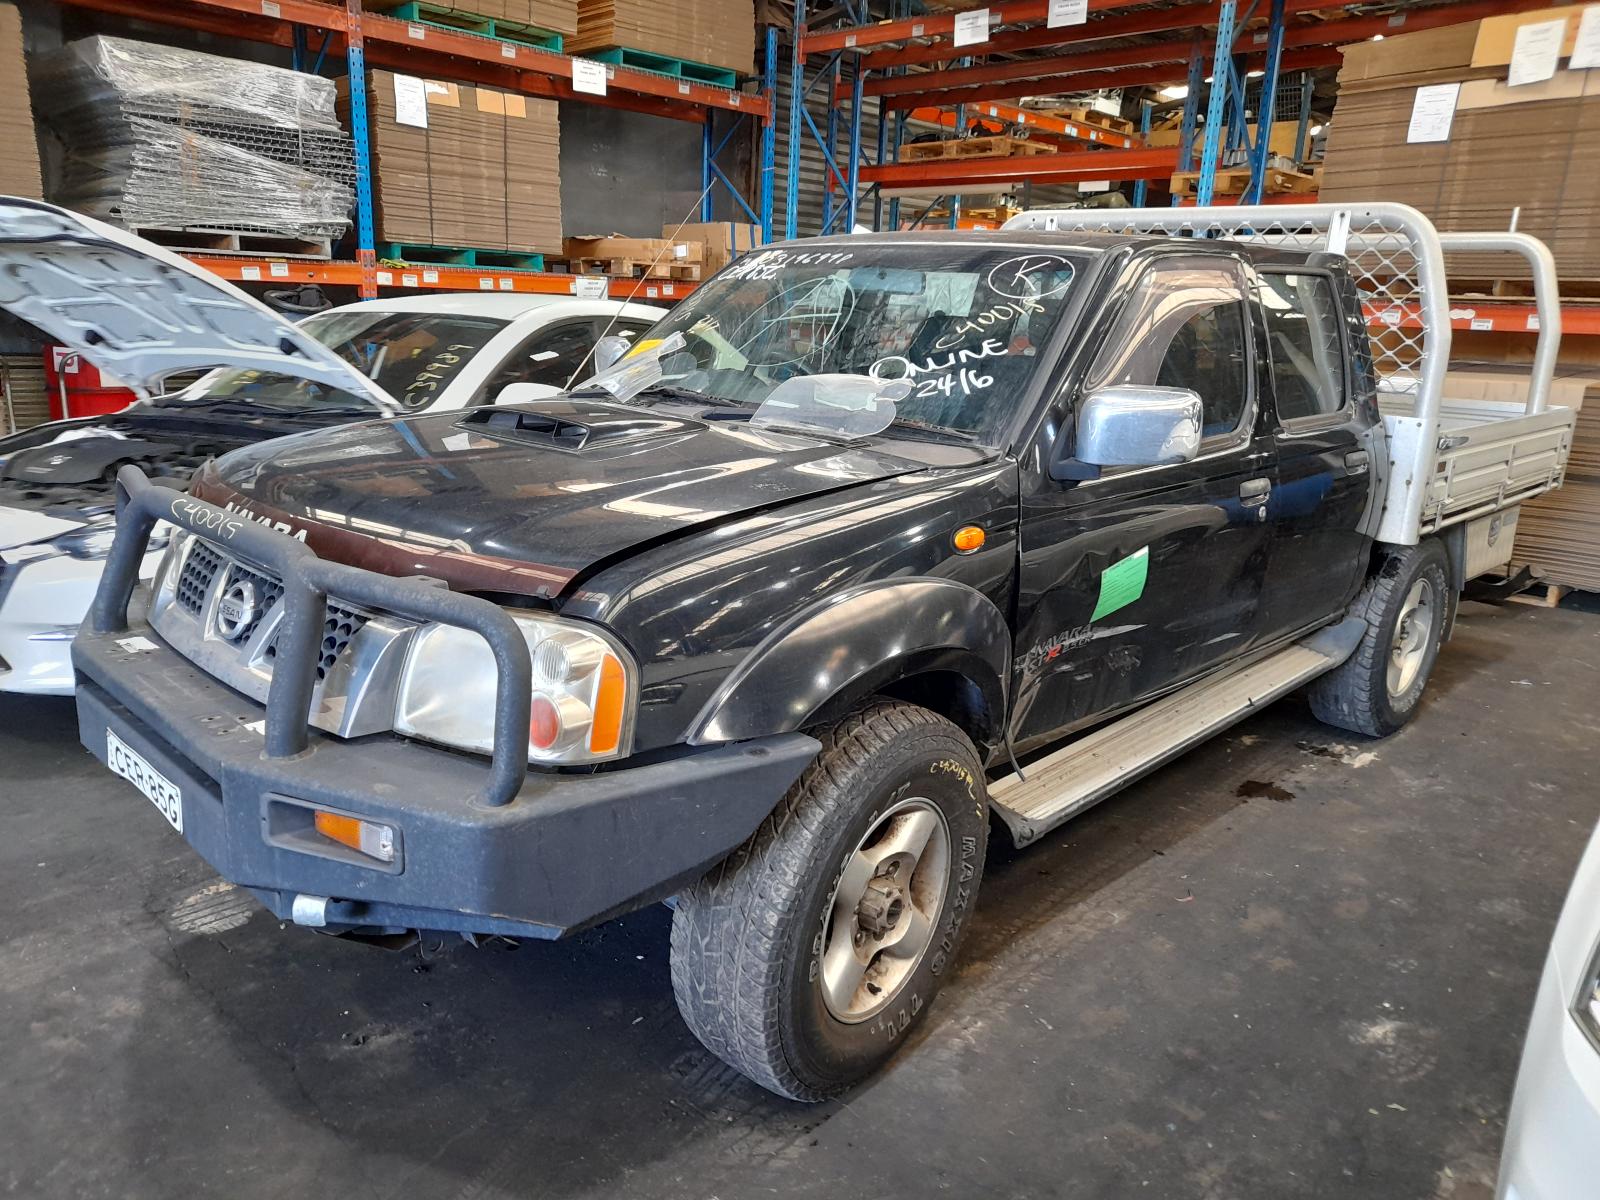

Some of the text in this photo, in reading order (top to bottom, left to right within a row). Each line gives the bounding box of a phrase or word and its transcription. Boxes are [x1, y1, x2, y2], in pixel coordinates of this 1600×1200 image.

[869, 338, 1009, 381] ONLINE
[915, 368, 994, 398] 24/6
[171, 499, 243, 539] C40015
[930, 836, 976, 976] MAXXIS
